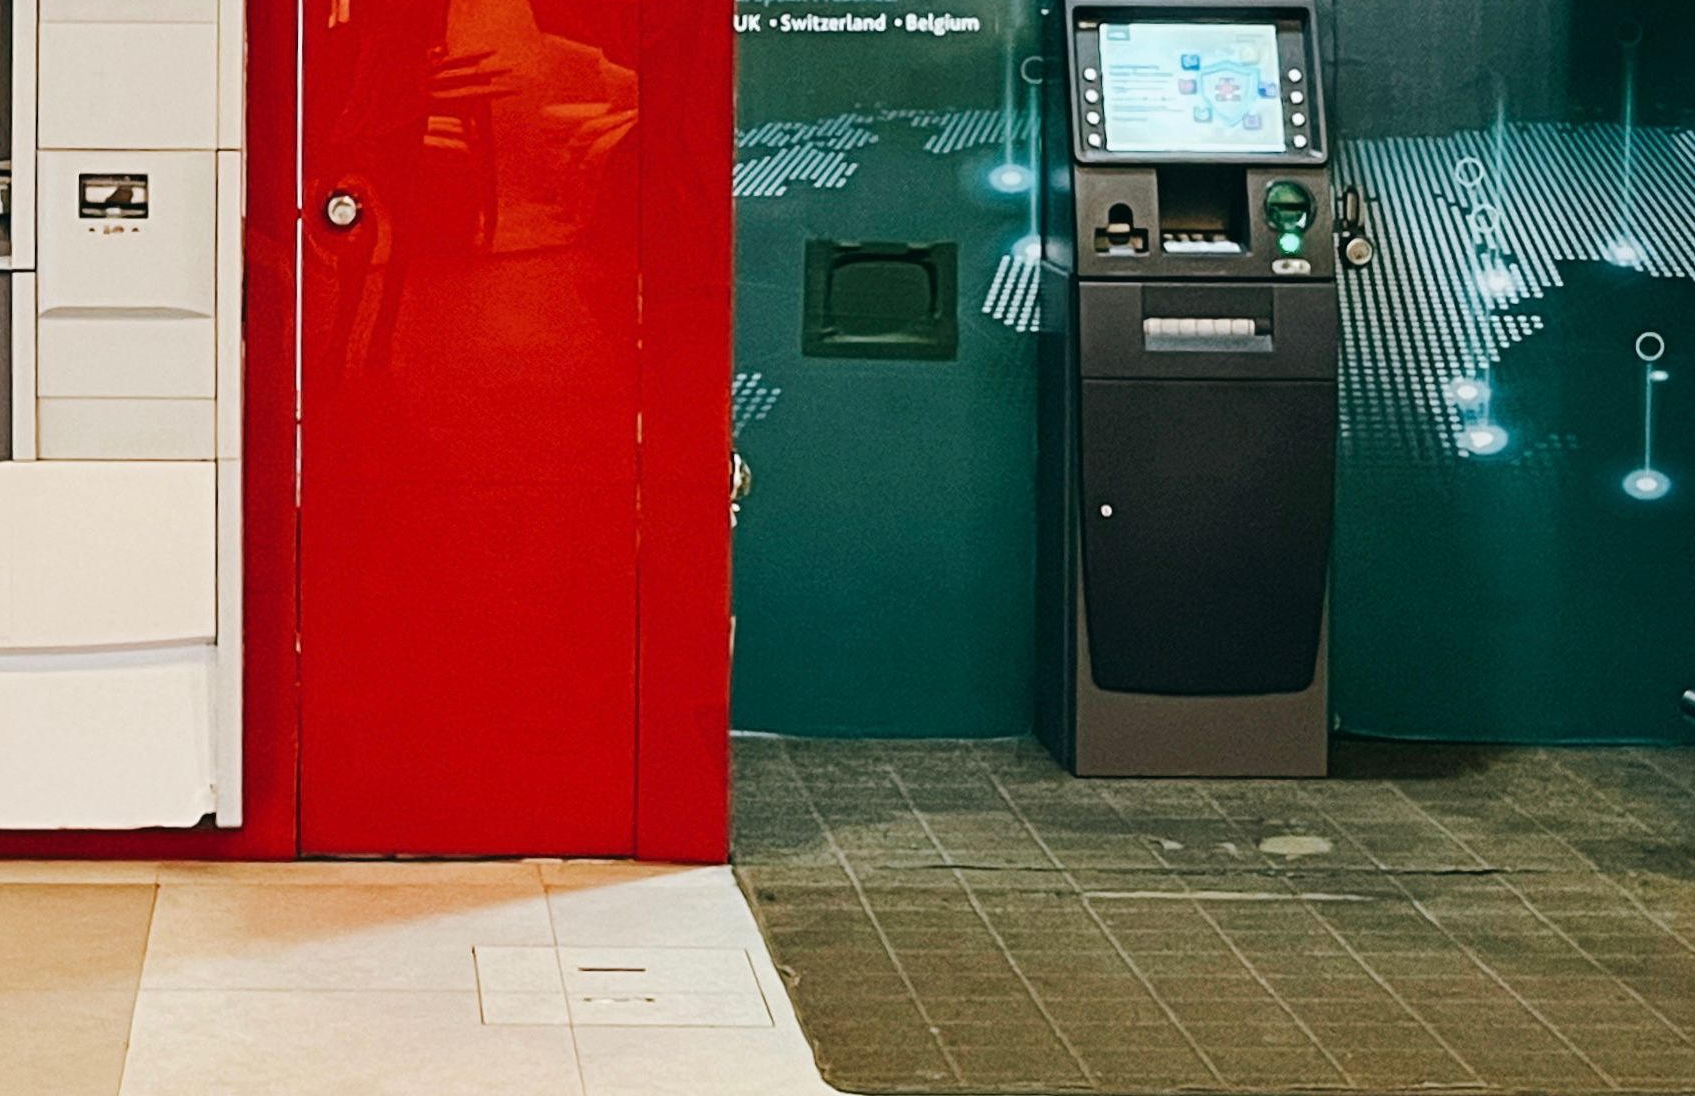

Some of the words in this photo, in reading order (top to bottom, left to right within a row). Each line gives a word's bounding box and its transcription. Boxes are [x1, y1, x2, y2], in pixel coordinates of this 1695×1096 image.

[733, 14, 761, 33] UK
[780, 13, 887, 32] Switzerland
[905, 13, 980, 36] Belgium
